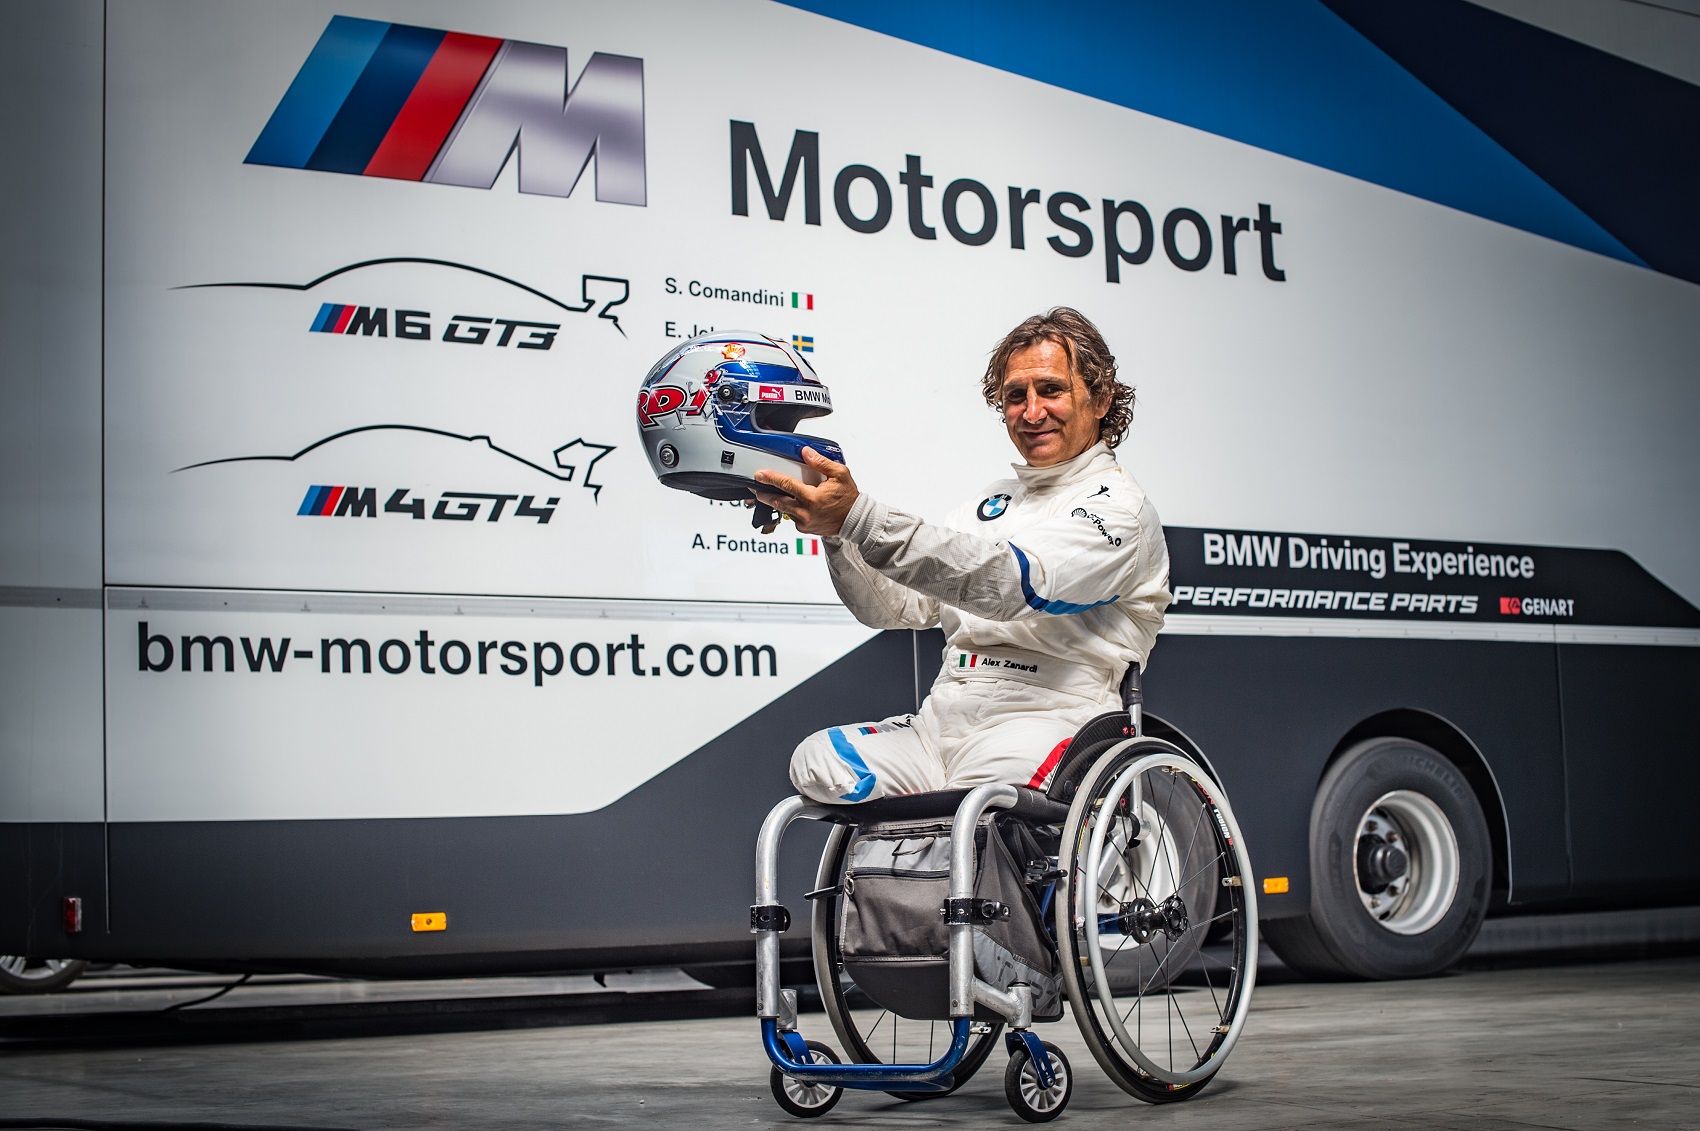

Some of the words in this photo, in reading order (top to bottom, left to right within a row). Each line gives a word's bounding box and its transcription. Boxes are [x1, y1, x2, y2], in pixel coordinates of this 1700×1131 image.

[730, 119, 1287, 284] Motorsport
[665, 277, 683, 295] S.
[689, 280, 784, 307] Comandini
[442, 316, 561, 351] GT3
[795, 390, 821, 402] BMW
[692, 533, 711, 550] A.
[717, 534, 789, 555] Fontana
[1204, 533, 1282, 567] BMW
[1288, 537, 1386, 579] Driving
[1394, 543, 1534, 581] Experience
[1173, 586, 1388, 611] PERFORMANCE
[1390, 593, 1479, 613] PARTS
[1521, 598, 1574, 616] GENART
[138, 620, 778, 687] bmw-motorsport.com
[981, 657, 1001, 668] Alex
[1003, 659, 1039, 674] Zanardi
